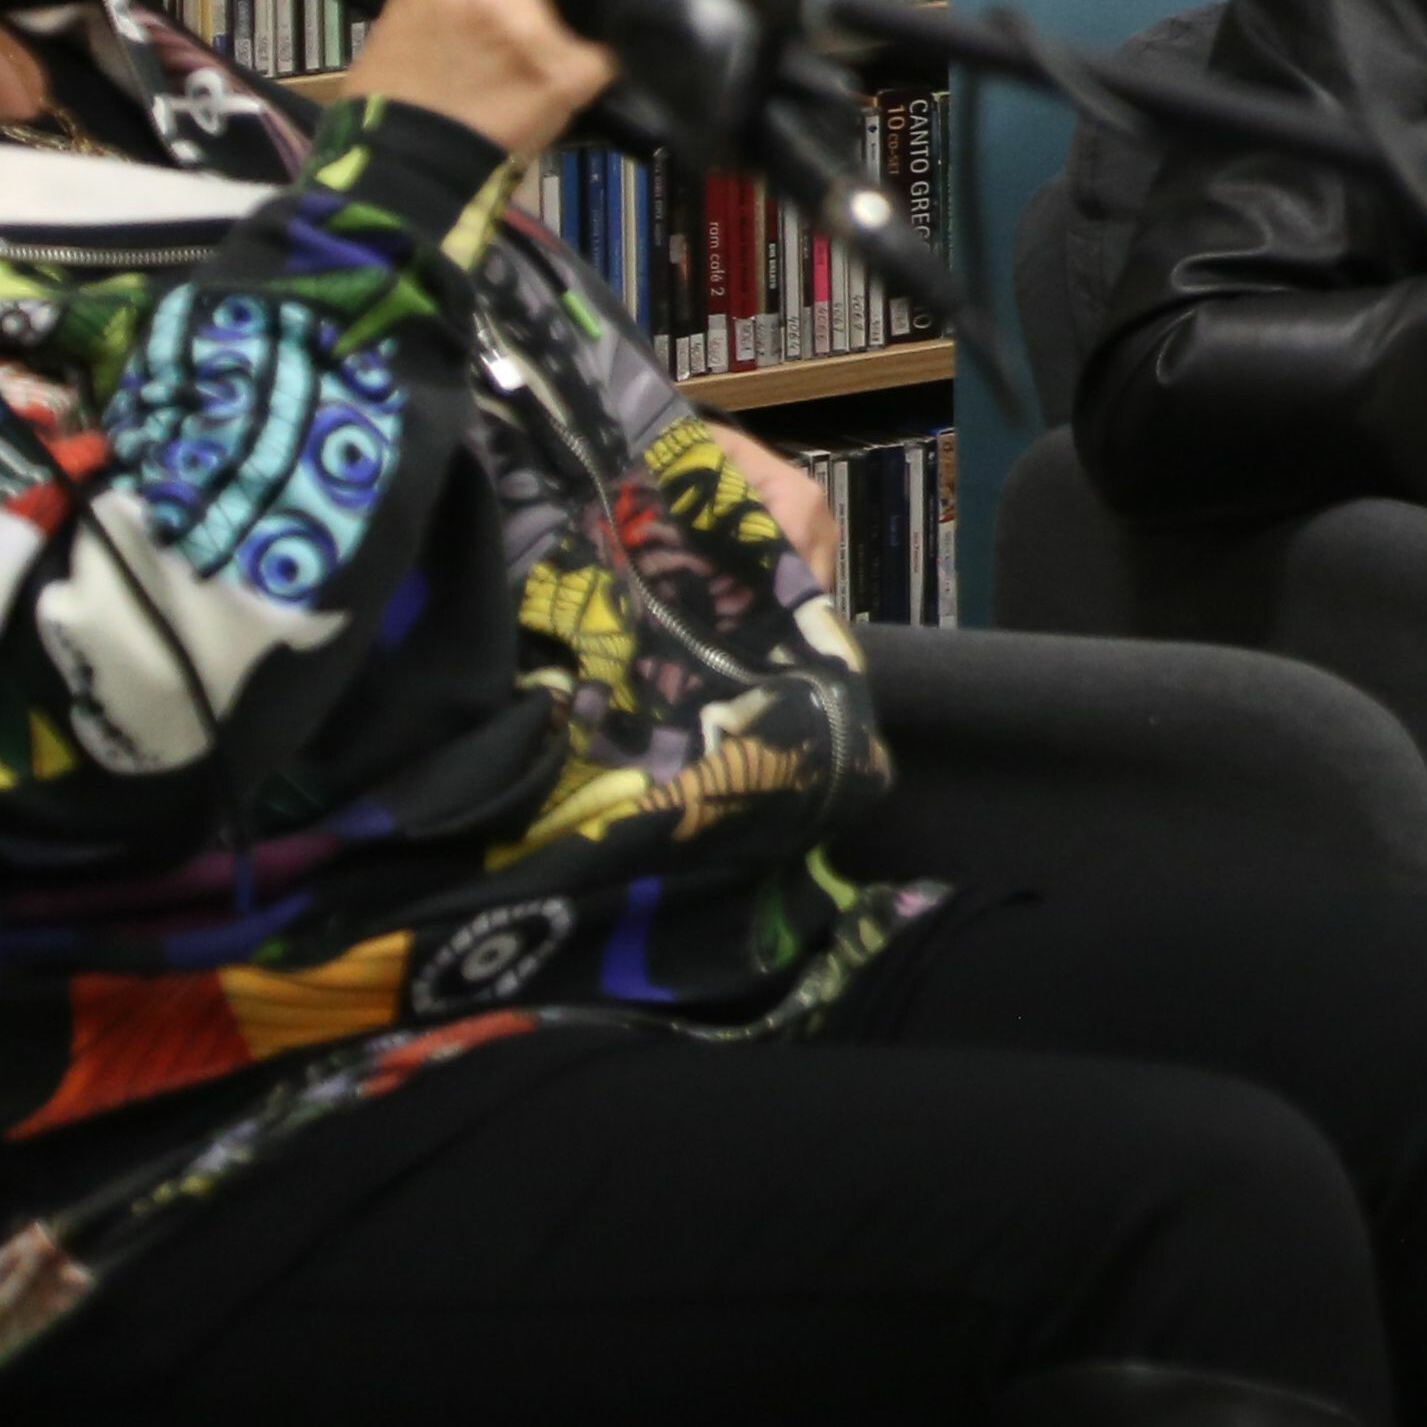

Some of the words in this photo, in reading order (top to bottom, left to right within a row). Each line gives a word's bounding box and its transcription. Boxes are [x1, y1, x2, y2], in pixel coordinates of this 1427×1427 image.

[887, 104, 906, 129] 10
[908, 99, 929, 174] CANTO
[711, 287, 725, 296] 2
